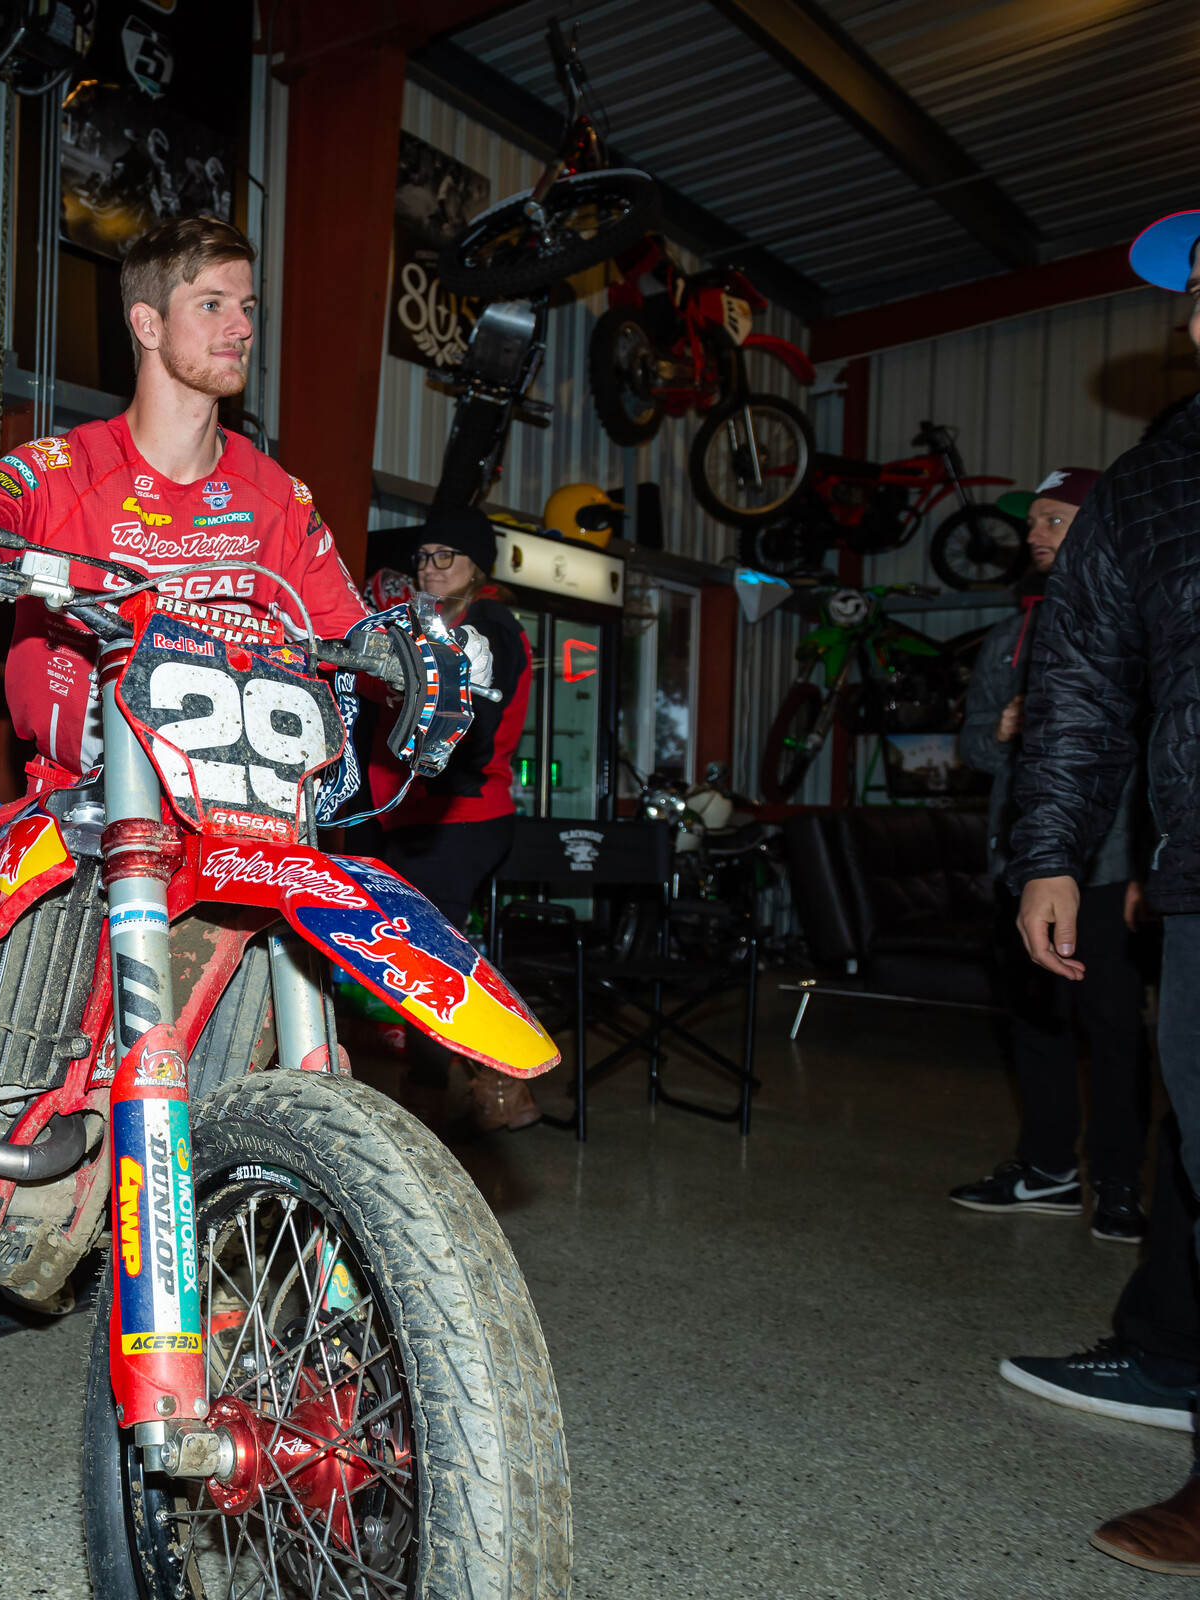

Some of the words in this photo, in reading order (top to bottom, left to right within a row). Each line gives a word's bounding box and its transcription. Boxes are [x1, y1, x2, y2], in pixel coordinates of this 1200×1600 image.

[204, 482, 230, 493] AMA
[207, 512, 251, 526] MOTOREX
[102, 572, 256, 599] GSGAS
[156, 595, 276, 635] RENTHAL
[153, 633, 184, 652] Red
[184, 638, 215, 657] Bull
[47, 660, 77, 675] OAKLEY
[47, 669, 75, 685] SENA
[148, 661, 326, 823] 29
[213, 811, 288, 834] GASGAS
[150, 1133, 175, 1296] DUNLOP
[177, 1174, 198, 1294] MOTOREX
[272, 1435, 312, 1456] Kite
